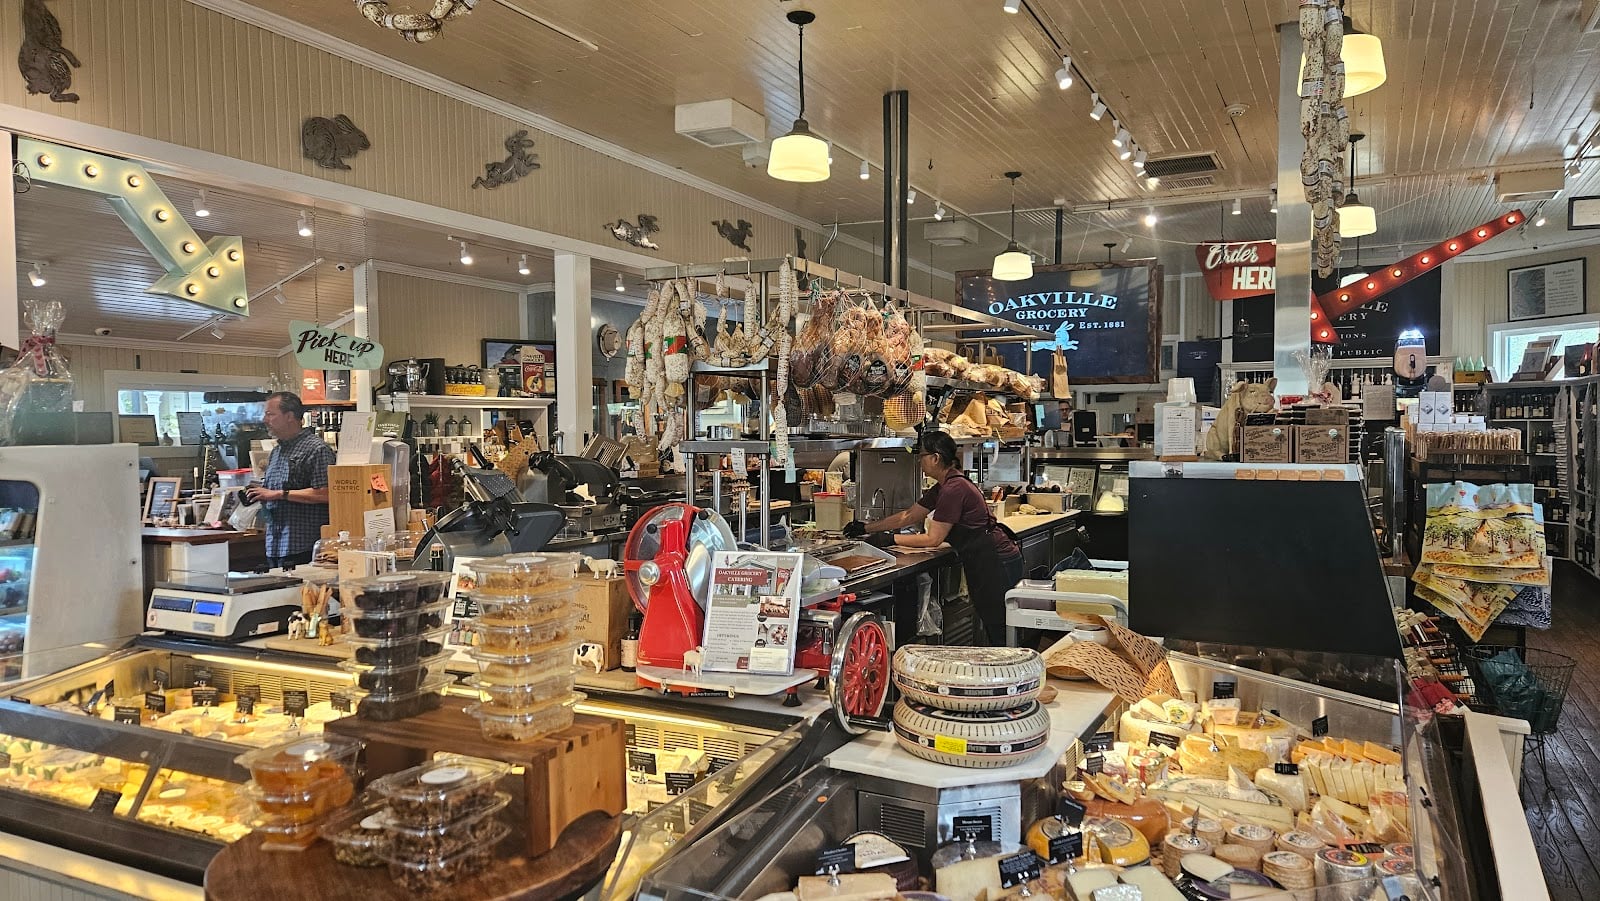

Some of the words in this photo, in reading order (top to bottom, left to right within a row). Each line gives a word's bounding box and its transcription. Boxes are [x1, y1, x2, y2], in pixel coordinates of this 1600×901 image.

[1205, 243, 1259, 270] Order
[988, 291, 1118, 315] OAKVILLE
[1016, 308, 1089, 320] GROCERY
[1104, 321, 1125, 329] 1881
[297, 329, 347, 353] Pick
[349, 340, 375, 357] up
[324, 348, 355, 367] HERE
